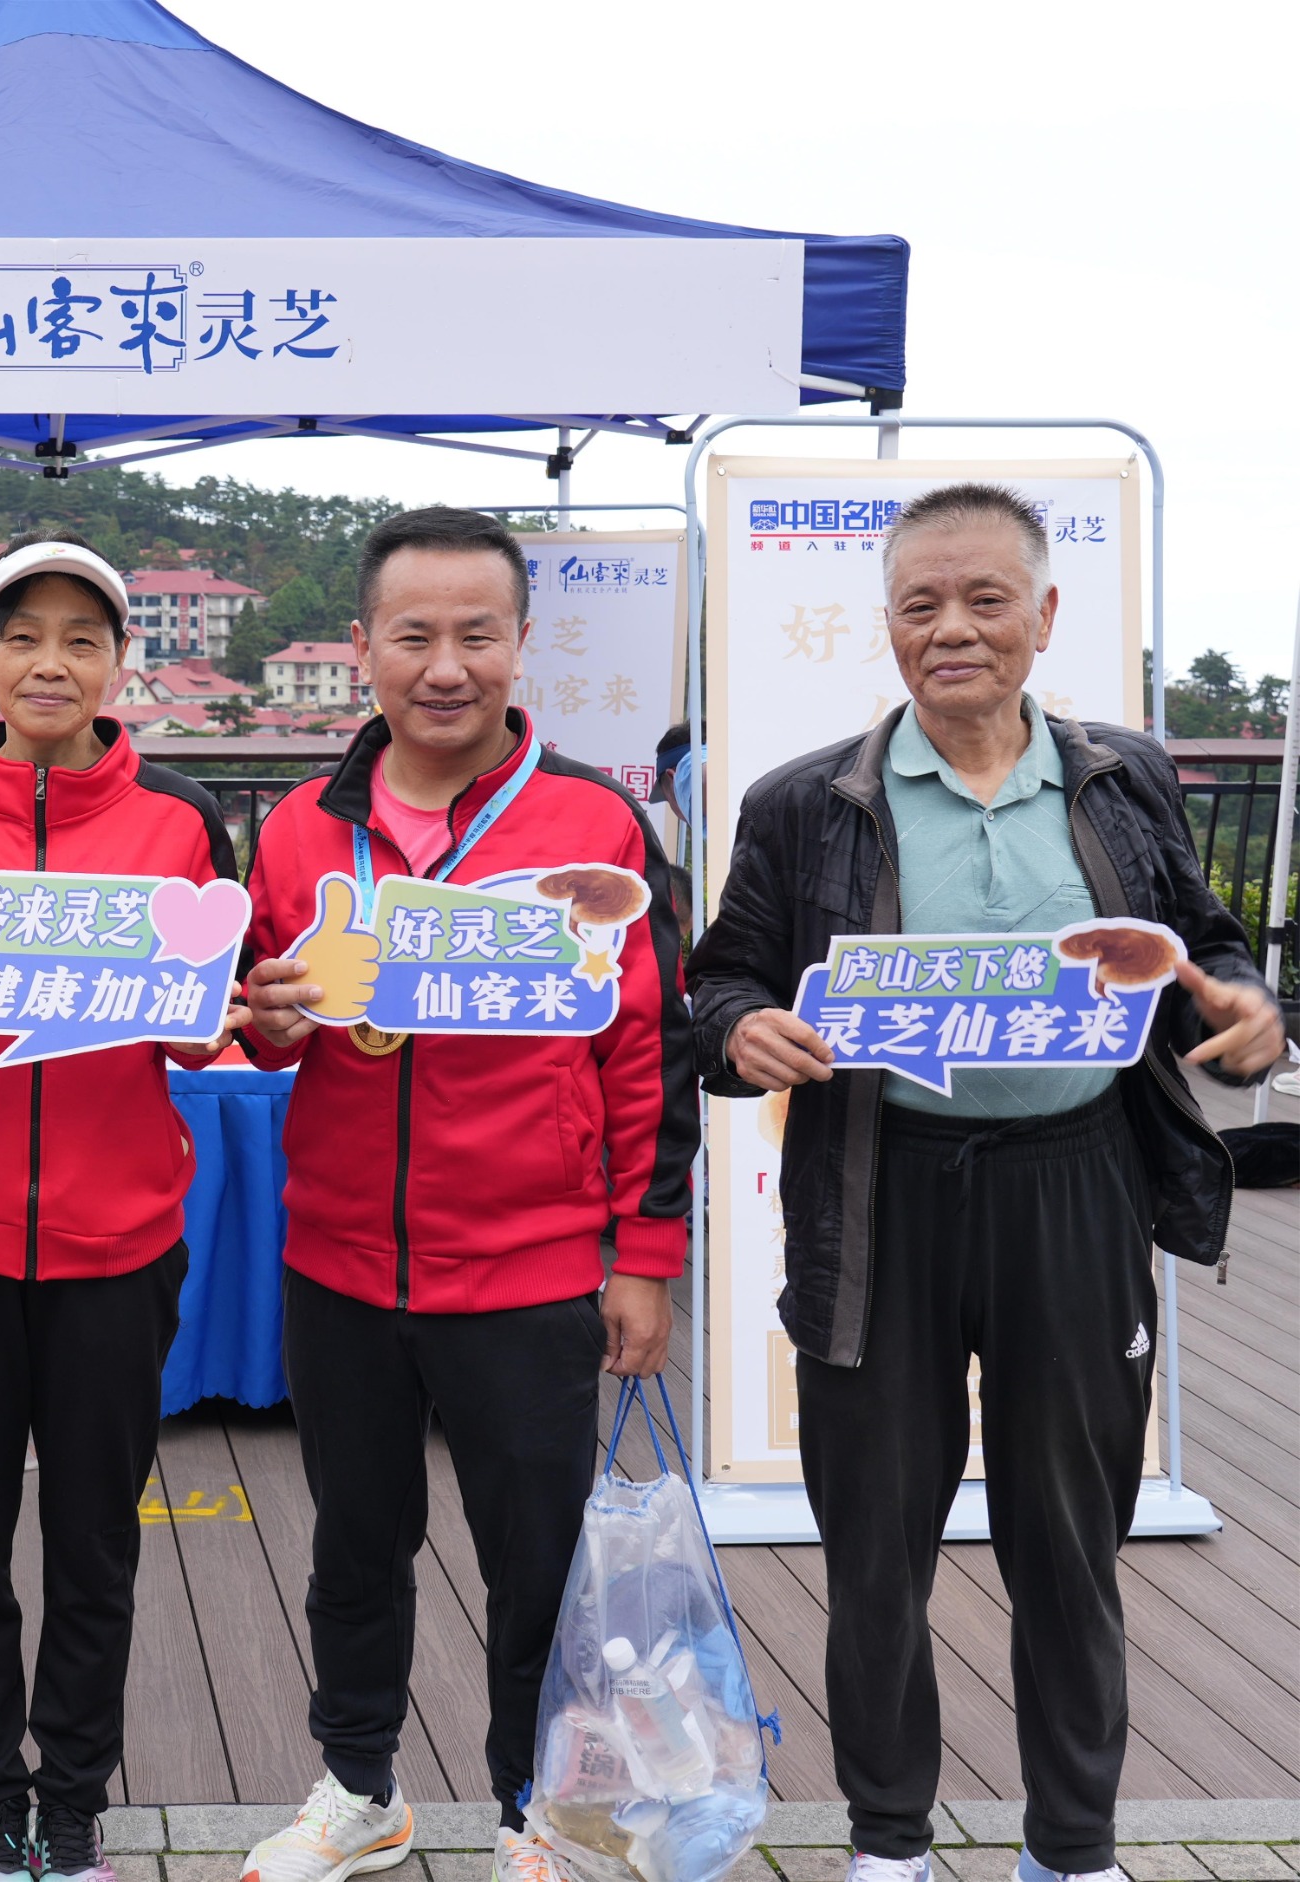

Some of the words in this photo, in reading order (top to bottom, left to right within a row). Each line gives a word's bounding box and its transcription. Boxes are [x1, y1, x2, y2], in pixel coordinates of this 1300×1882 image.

[1054, 516, 1106, 543] 灵芝
[388, 906, 563, 960] 好灵芝
[832, 945, 1050, 993] 庐山天下悠
[413, 971, 578, 1021] 仙客来
[816, 1001, 1128, 1057] 灵芝仙客来
